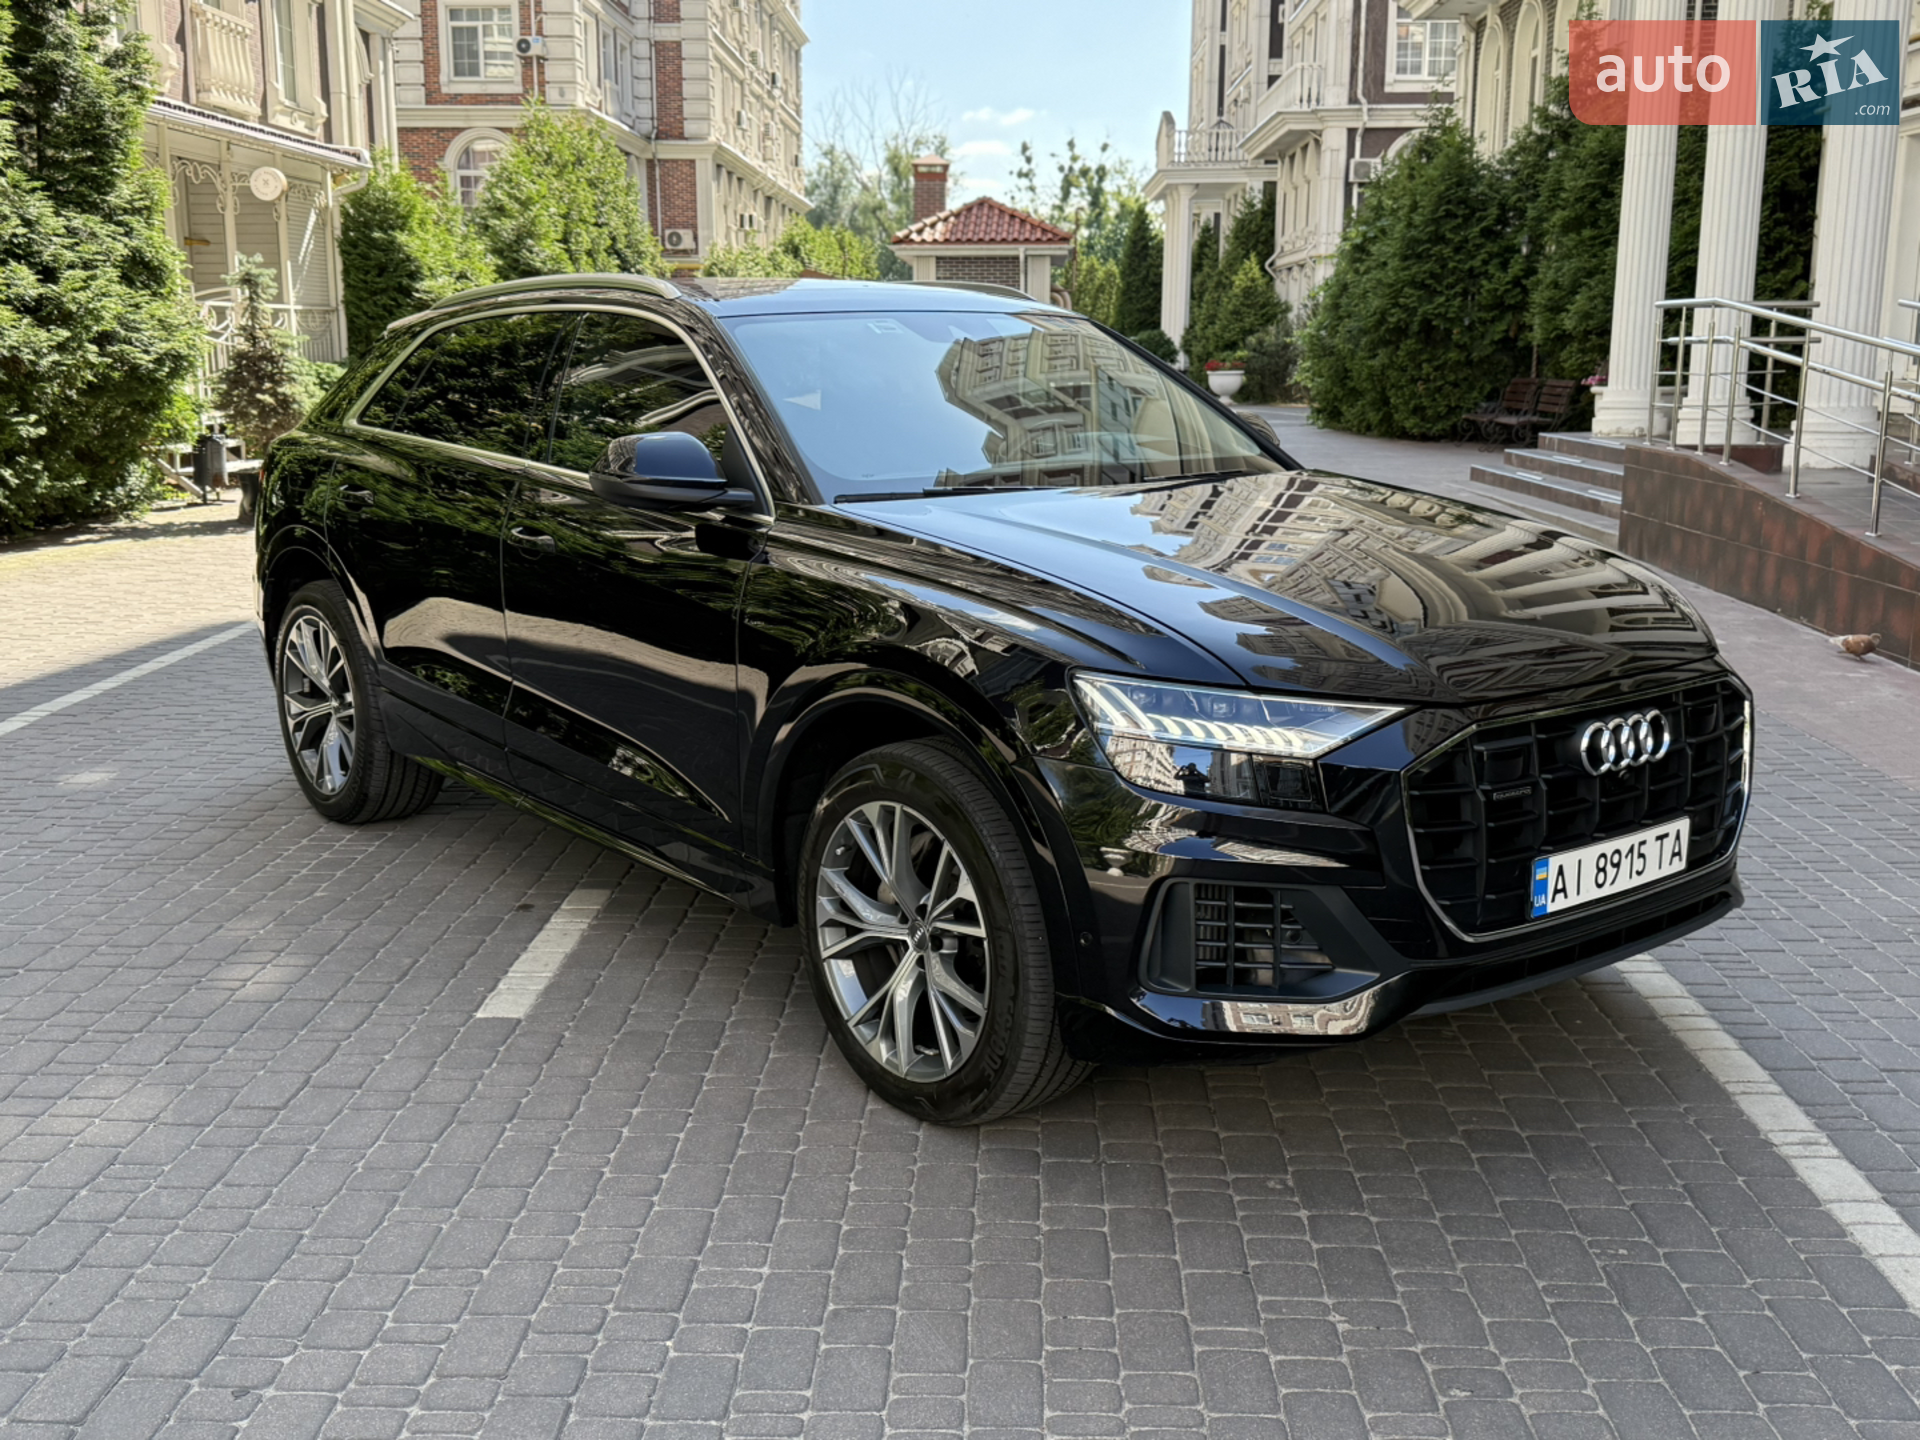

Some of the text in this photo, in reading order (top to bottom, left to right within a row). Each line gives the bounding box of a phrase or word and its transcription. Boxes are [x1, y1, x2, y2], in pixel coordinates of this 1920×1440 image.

[1550, 828, 1683, 904] AI 8915 TA
[1534, 893, 1546, 907] UA
